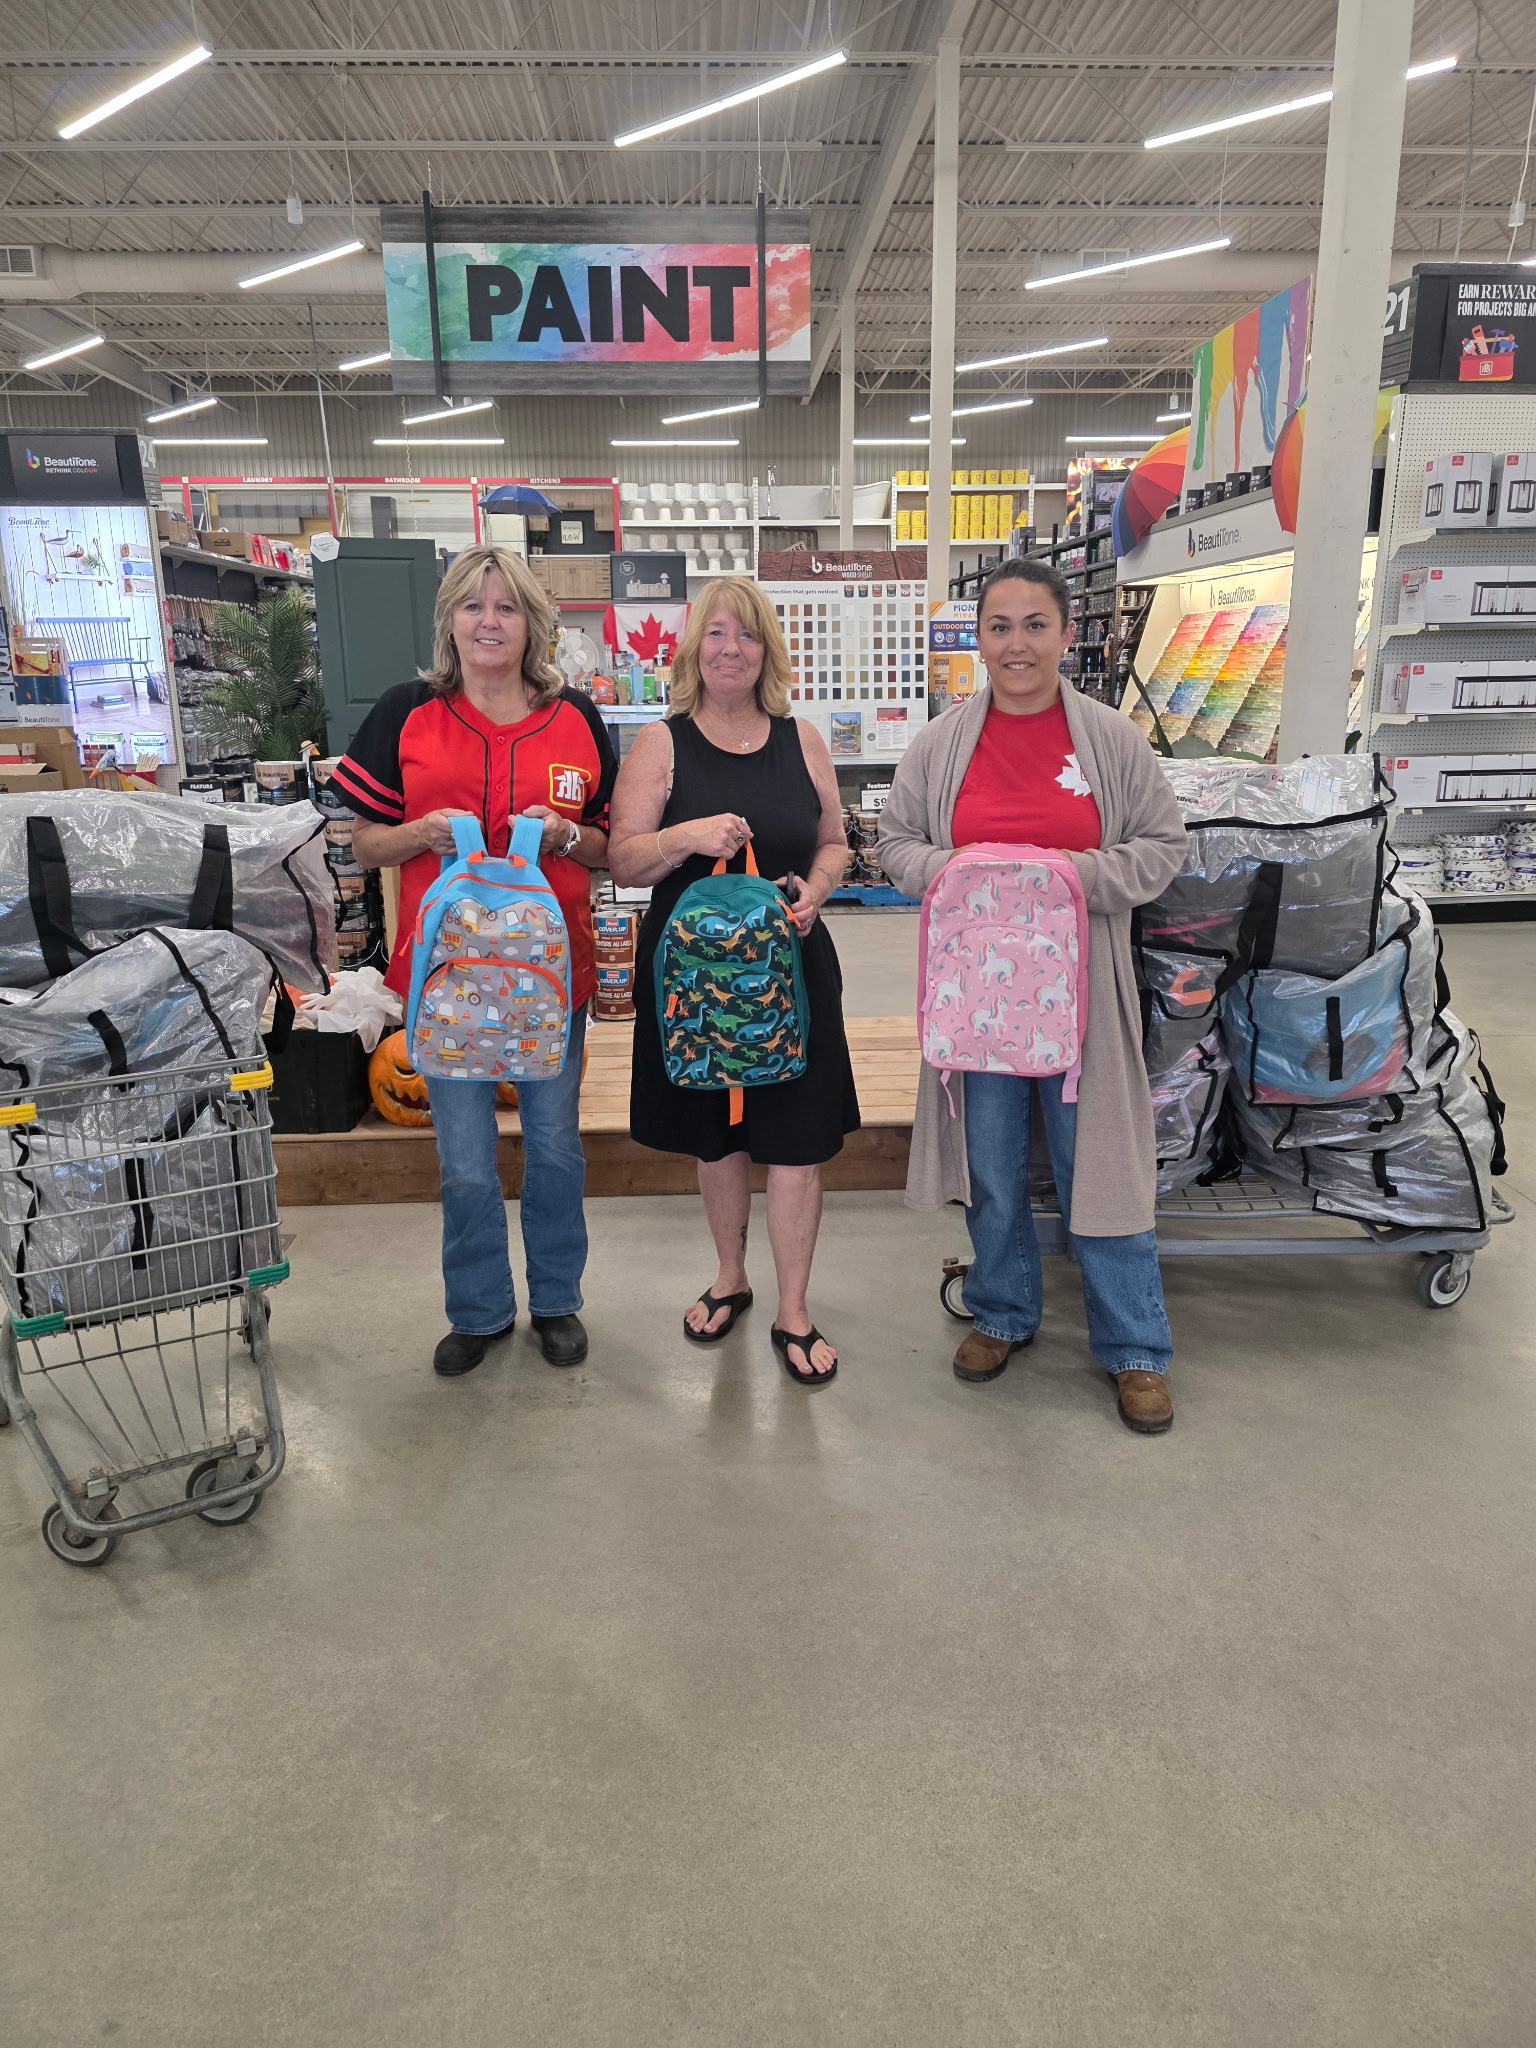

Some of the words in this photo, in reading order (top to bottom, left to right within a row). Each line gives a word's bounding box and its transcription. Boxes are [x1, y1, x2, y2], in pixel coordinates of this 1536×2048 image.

[1458, 283, 1480, 299] EARN
[465, 264, 751, 343] PAINT
[1383, 286, 1411, 337] 21
[1457, 301, 1473, 316] FOR
[1474, 301, 1513, 317] PROJECTS
[1513, 302, 1527, 317] BIG
[138, 440, 156, 469] 24
[825, 563, 873, 572] BeautiTone
[841, 571, 857, 579] WOOD
[857, 571, 873, 579] SHIELD
[599, 977, 620, 985] COVER
